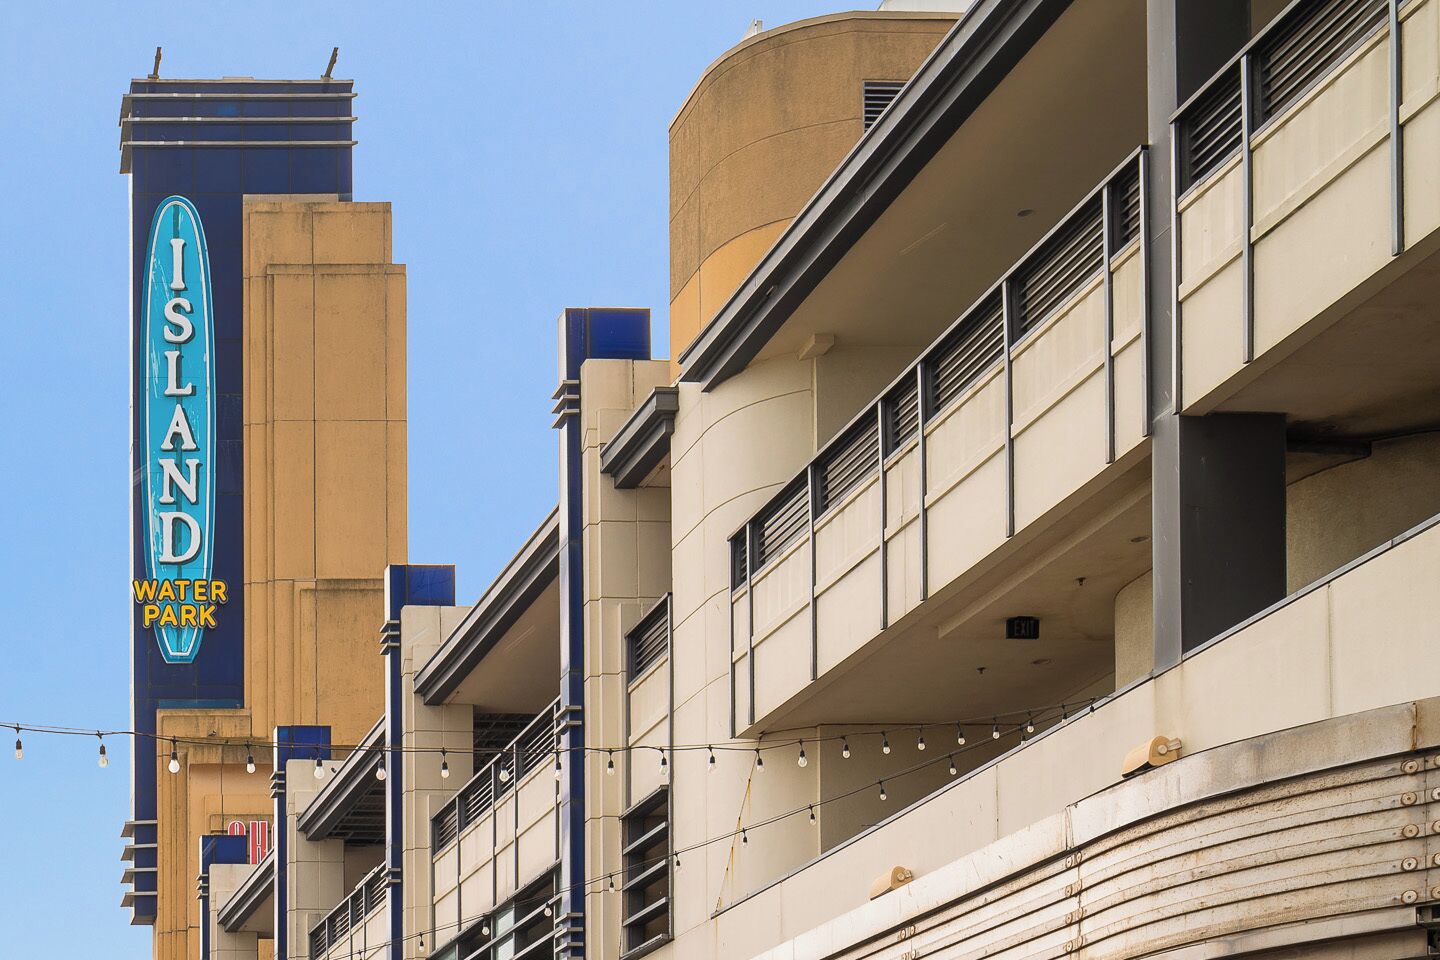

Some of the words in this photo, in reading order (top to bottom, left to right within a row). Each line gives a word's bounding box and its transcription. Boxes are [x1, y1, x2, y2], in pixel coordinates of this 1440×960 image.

[159, 238, 202, 564] ISLAND
[133, 578, 228, 603] WATER
[142, 602, 217, 629] PARK
